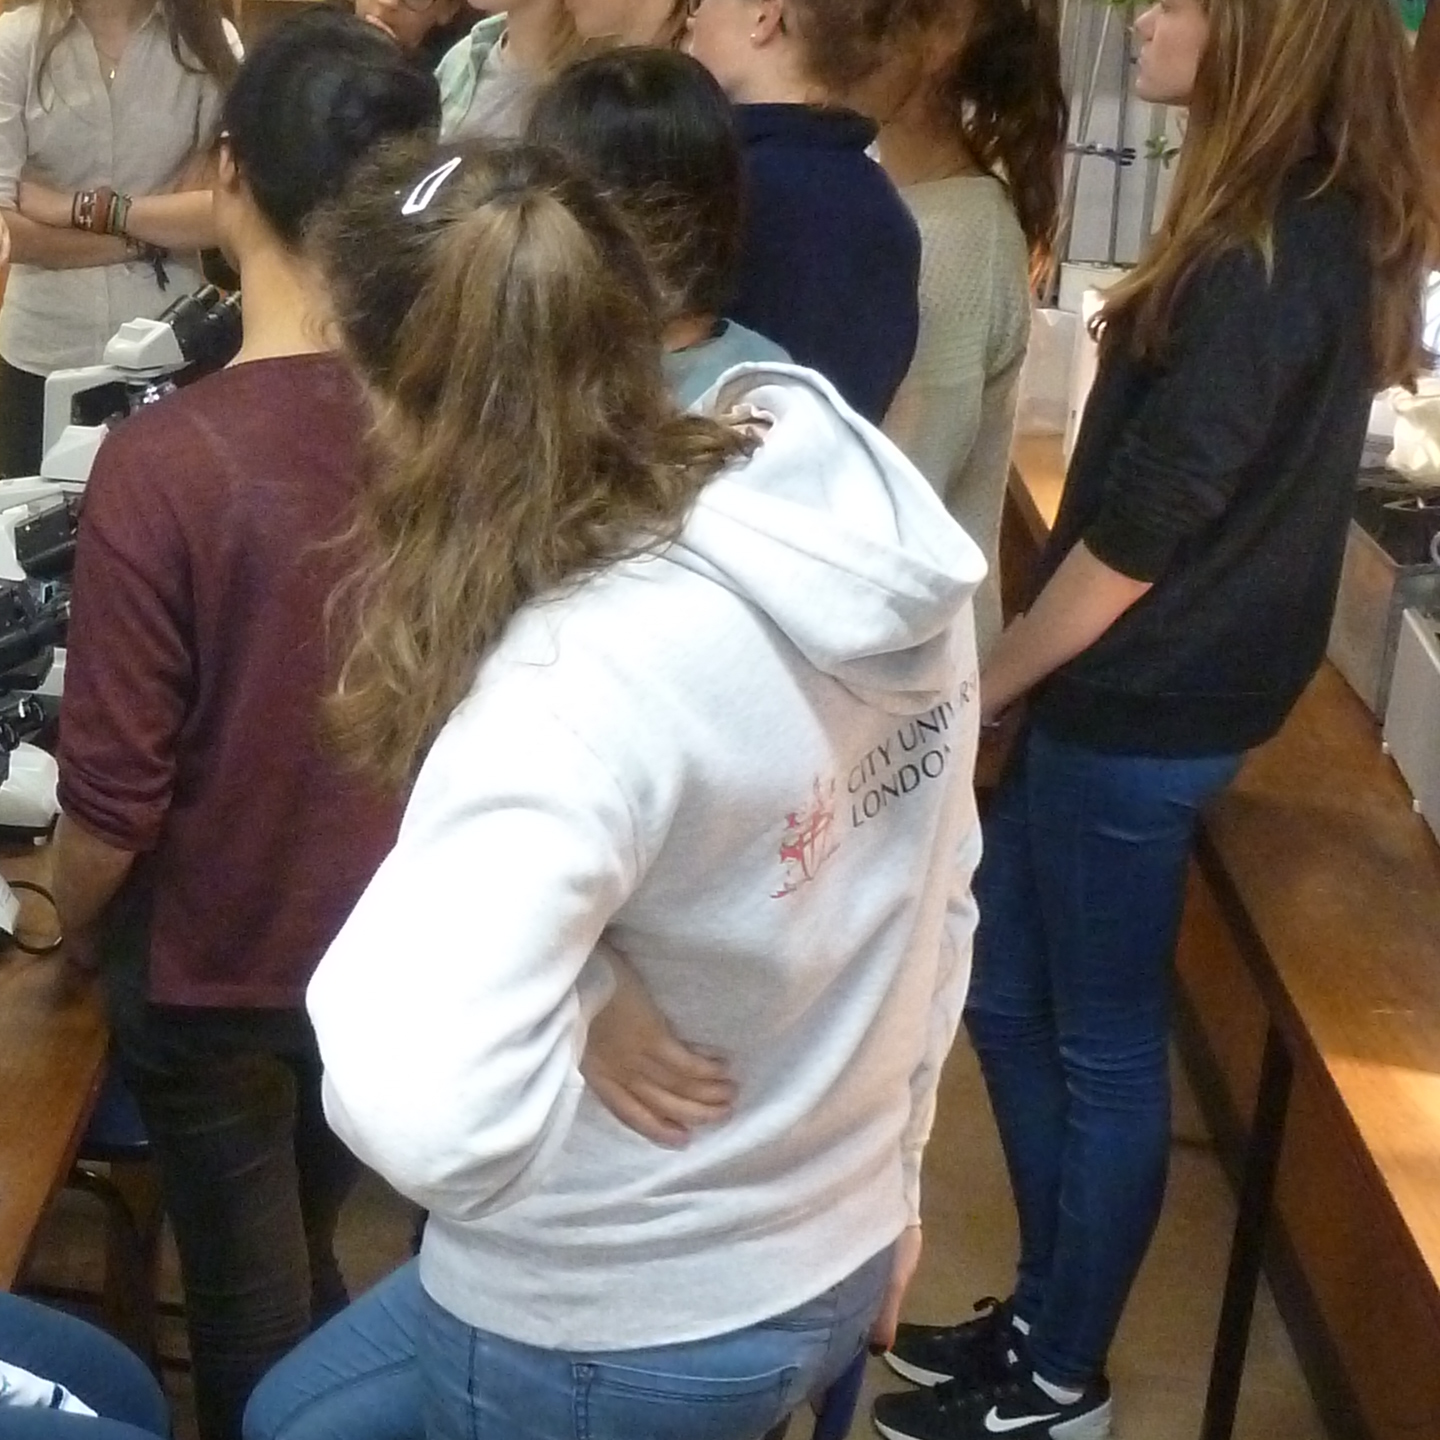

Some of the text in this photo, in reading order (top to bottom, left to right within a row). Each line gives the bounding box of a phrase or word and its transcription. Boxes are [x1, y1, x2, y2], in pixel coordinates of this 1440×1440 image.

[848, 671, 977, 794] CITY UNIR
[852, 743, 951, 828] LONDO
